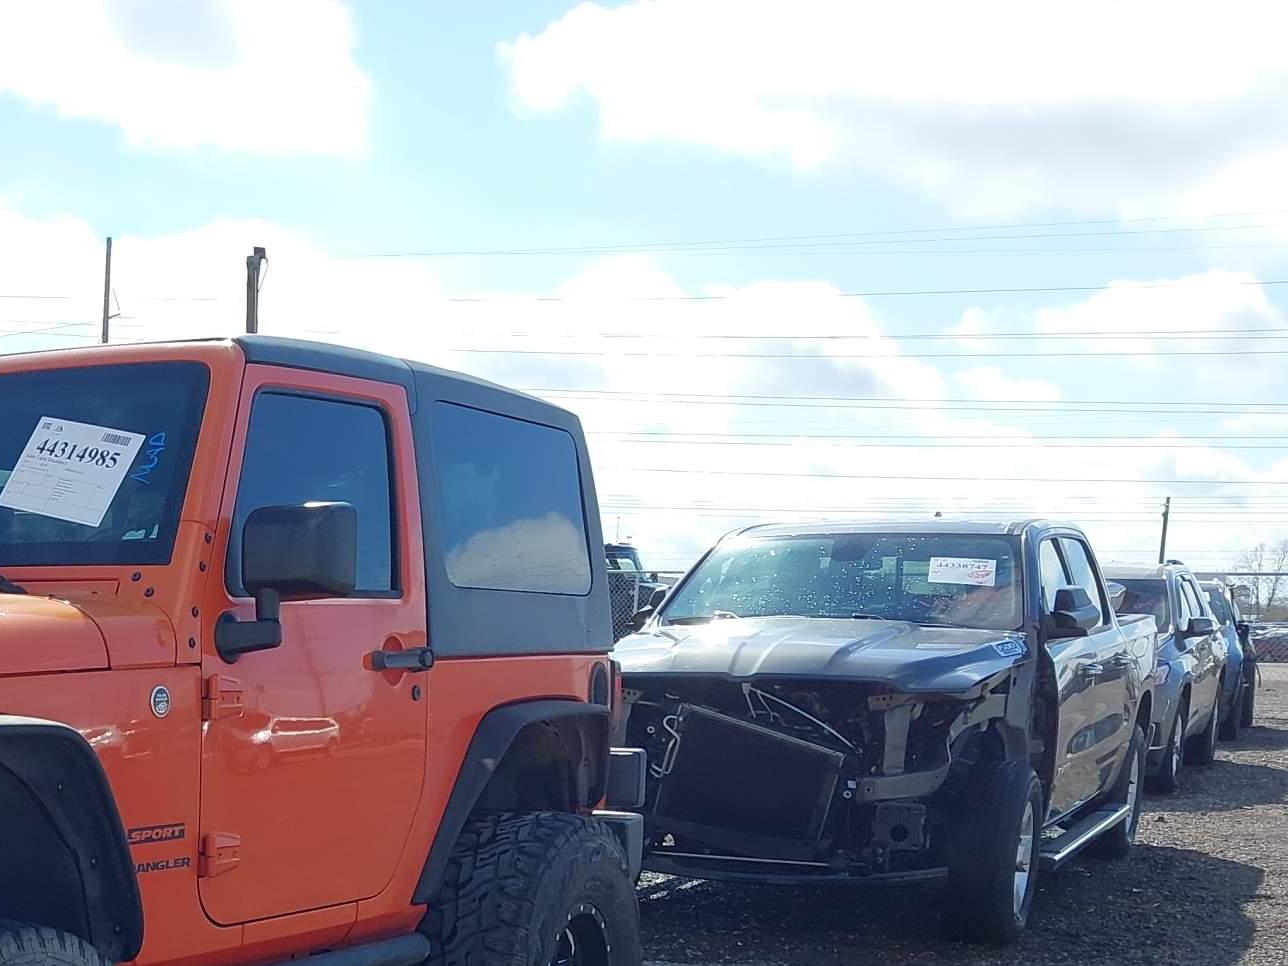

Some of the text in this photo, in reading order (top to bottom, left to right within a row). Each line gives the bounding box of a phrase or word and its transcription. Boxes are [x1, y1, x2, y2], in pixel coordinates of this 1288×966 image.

[36, 438, 121, 469] 44314985
[128, 825, 185, 843] SPORT
[134, 857, 191, 873] ANGLER
